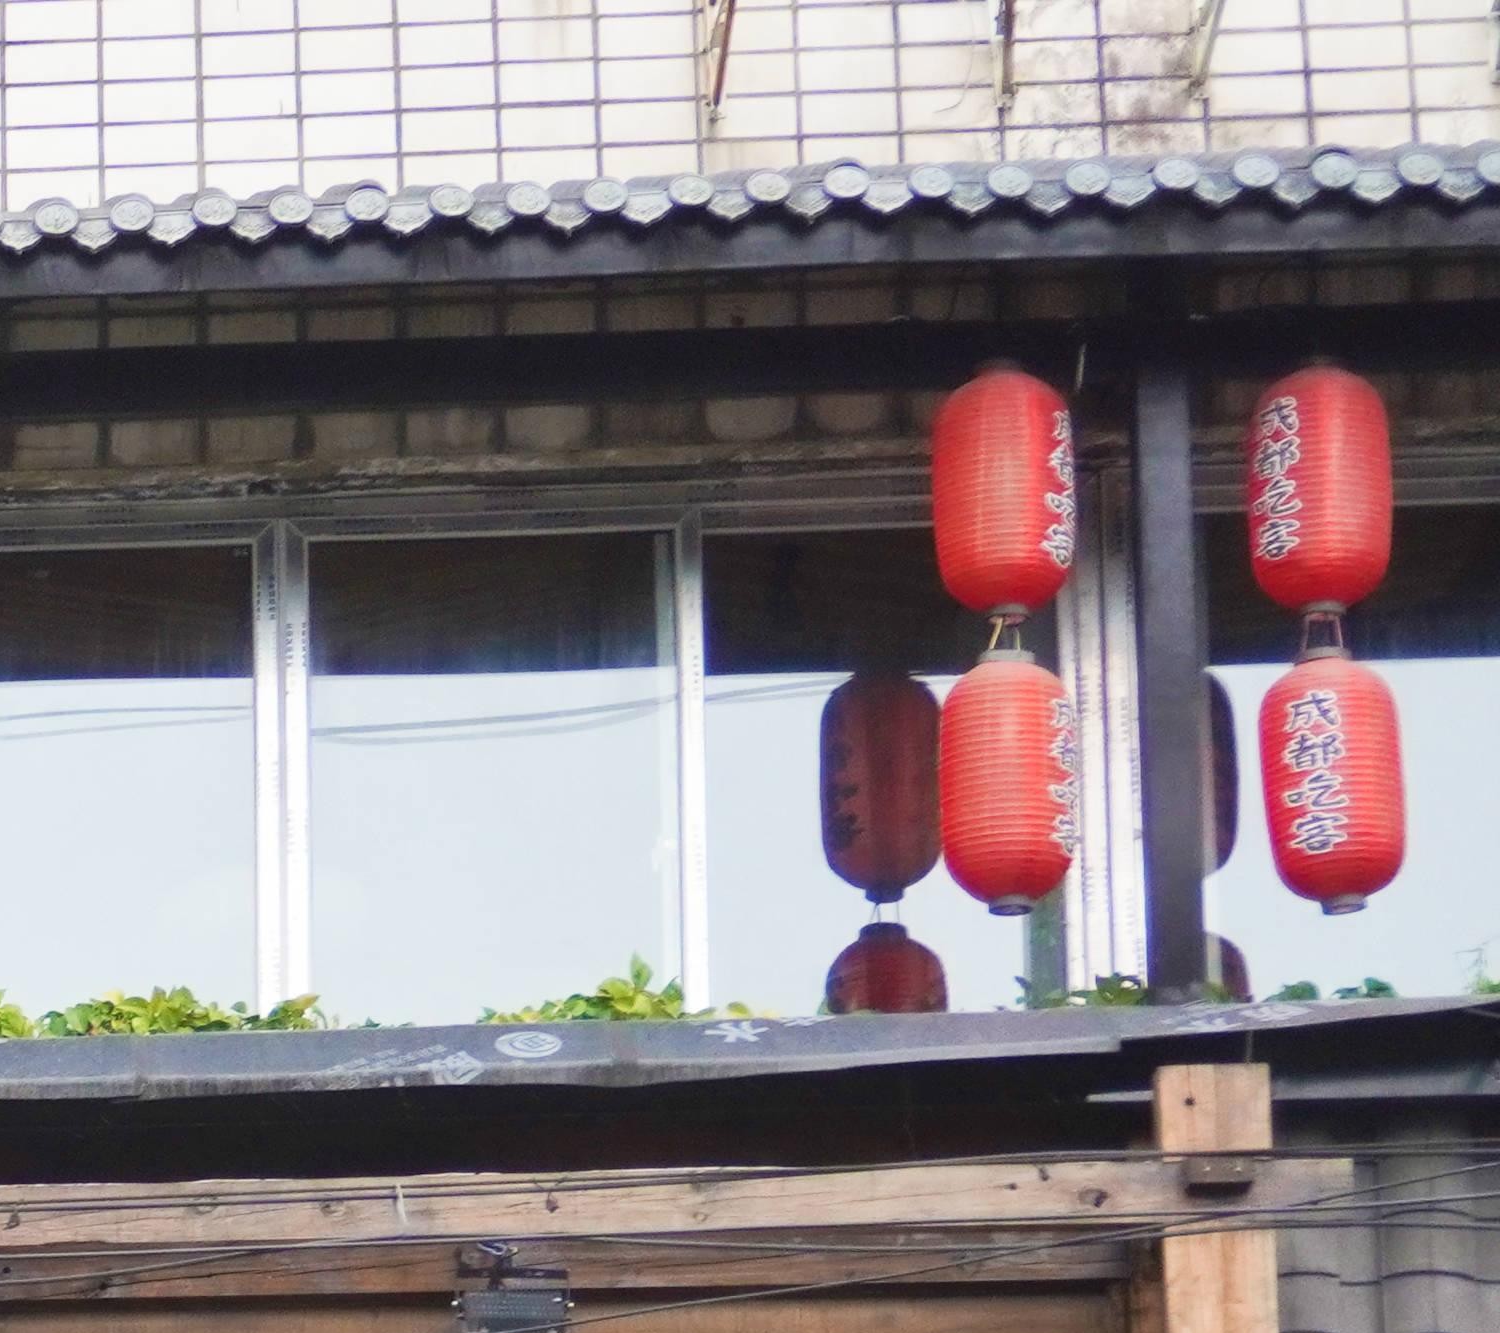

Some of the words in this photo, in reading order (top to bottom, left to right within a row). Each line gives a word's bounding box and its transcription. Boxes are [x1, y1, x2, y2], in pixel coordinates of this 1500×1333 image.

[1253, 396, 1300, 561] 成都吃客
[1285, 690, 1348, 853] 成都吃客
